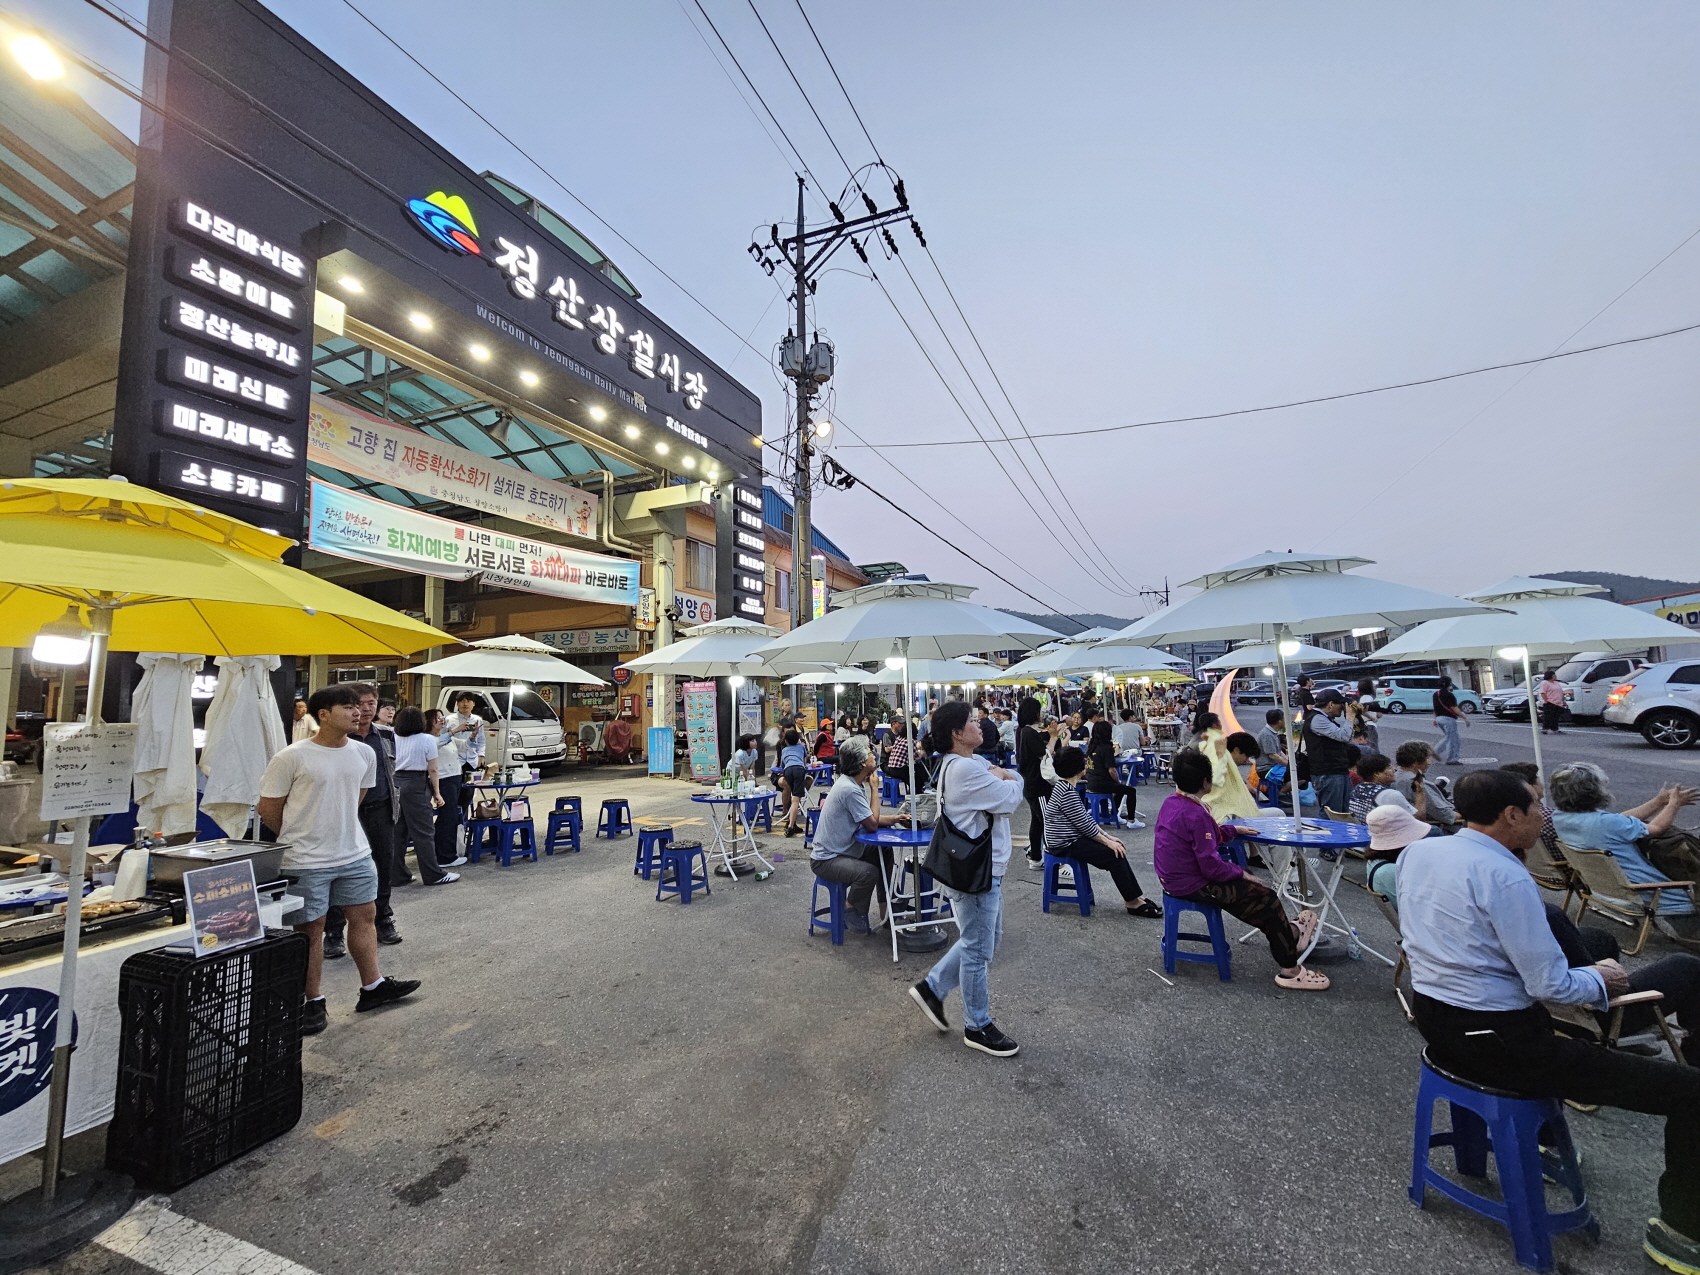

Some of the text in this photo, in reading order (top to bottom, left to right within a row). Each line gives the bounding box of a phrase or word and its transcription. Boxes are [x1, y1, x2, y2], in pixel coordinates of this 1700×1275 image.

[186, 202, 305, 277] 다모아식당
[190, 257, 295, 318] 소망이발
[179, 301, 300, 368] 정산농약사
[495, 236, 708, 410] 정산상설시장
[184, 355, 291, 410] 미래신발
[476, 304, 525, 342] Welcom
[529, 335, 540, 350] to
[594, 373, 617, 396] Daily
[619, 389, 648, 414] Market
[173, 404, 296, 458] 미래세탁소
[347, 425, 568, 515] 고향 집 자동확산소화기 설치로 효도하기
[441, 489, 472, 504] 충청남도
[345, 511, 373, 529] 방화문!
[469, 530, 491, 546] 나면
[495, 536, 515, 552] 대피
[519, 542, 542, 557] 먼저!
[387, 527, 629, 591] 화재예방 서로서로 화재대피 바로바로
[464, 568, 532, 588] 정시장상인회
[542, 632, 575, 646] 청양
[594, 629, 630, 645] 농산
[701, 604, 711, 621] 쌀
